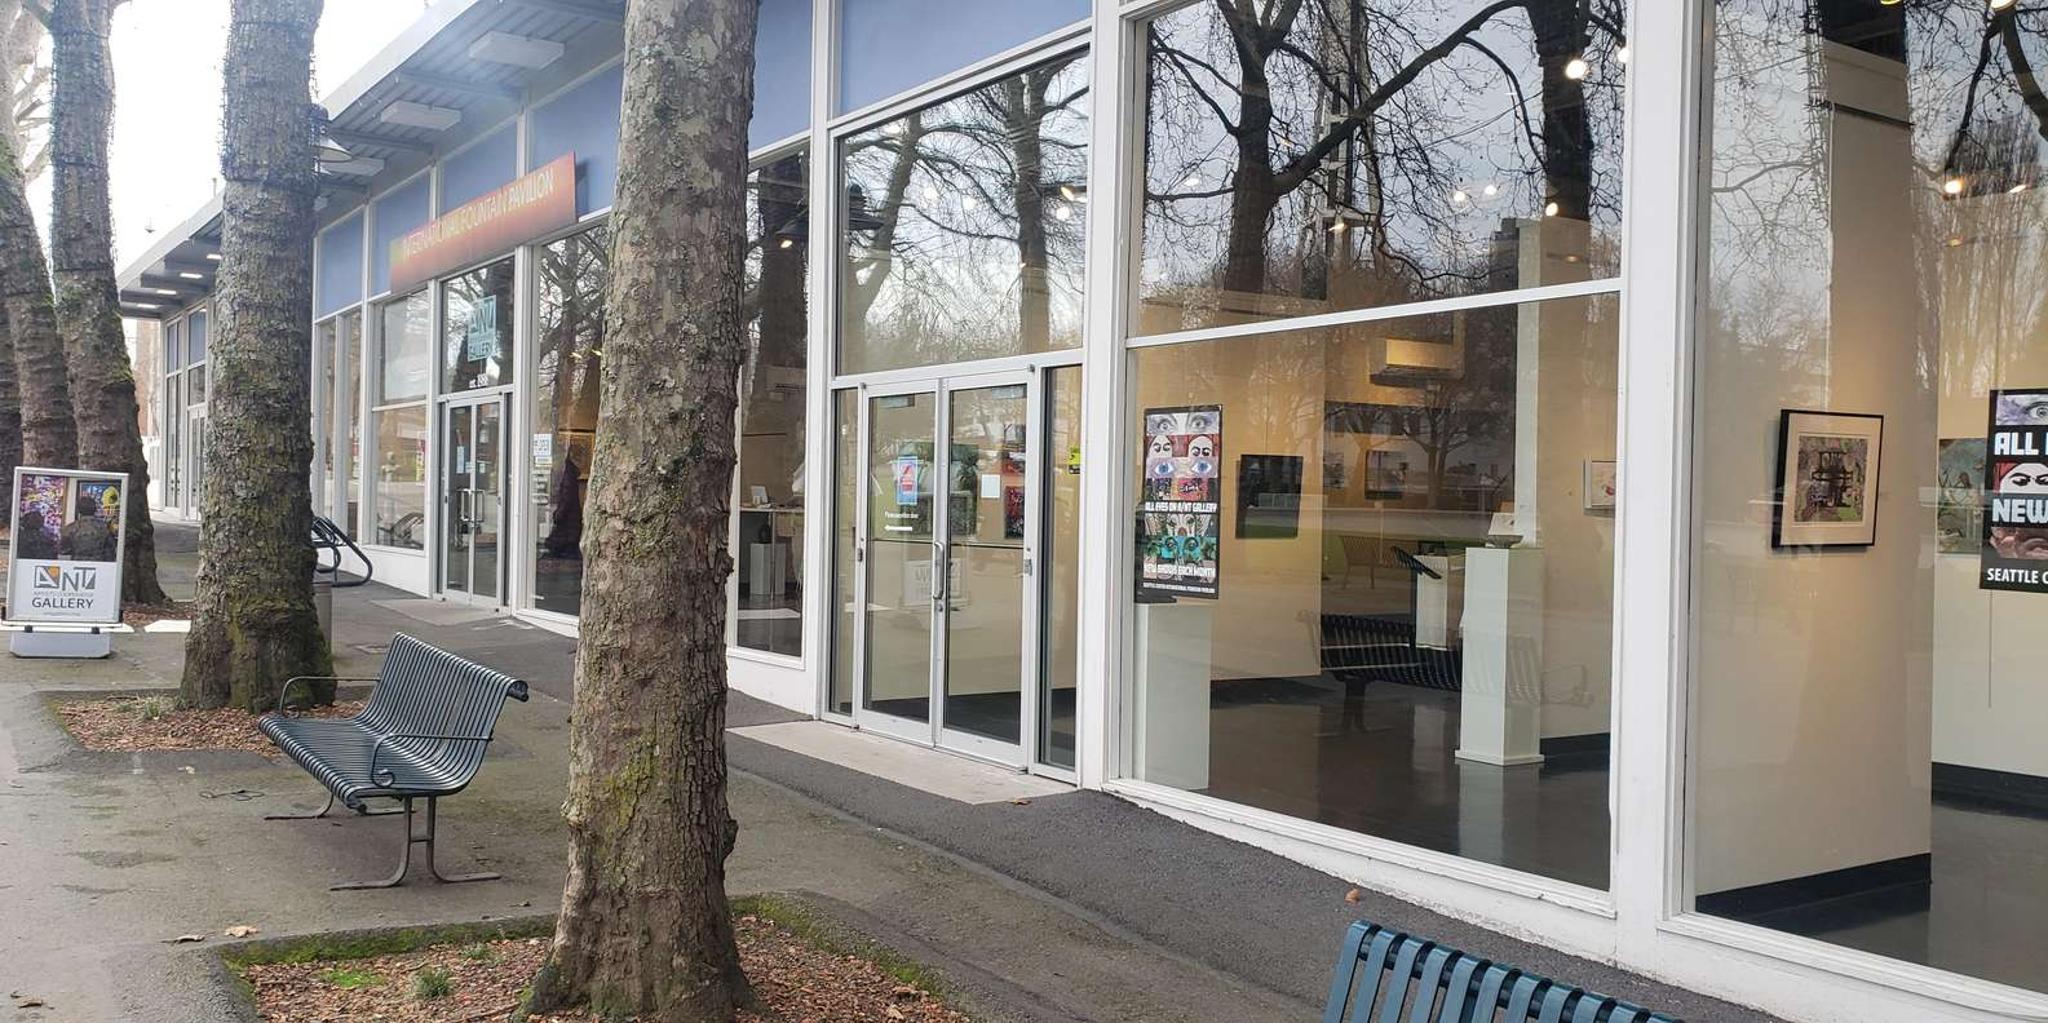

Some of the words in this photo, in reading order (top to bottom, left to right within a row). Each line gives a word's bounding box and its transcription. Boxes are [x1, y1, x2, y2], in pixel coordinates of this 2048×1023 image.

[460, 193, 508, 231] FOUNTAIN
[508, 171, 554, 210] PAVILION
[1993, 431, 2039, 456] ALL
[1192, 502, 1217, 514] GALLERY
[1991, 498, 2048, 524] NEW
[1986, 567, 2038, 585] SEATTLE
[31, 597, 94, 609] GALLERY
